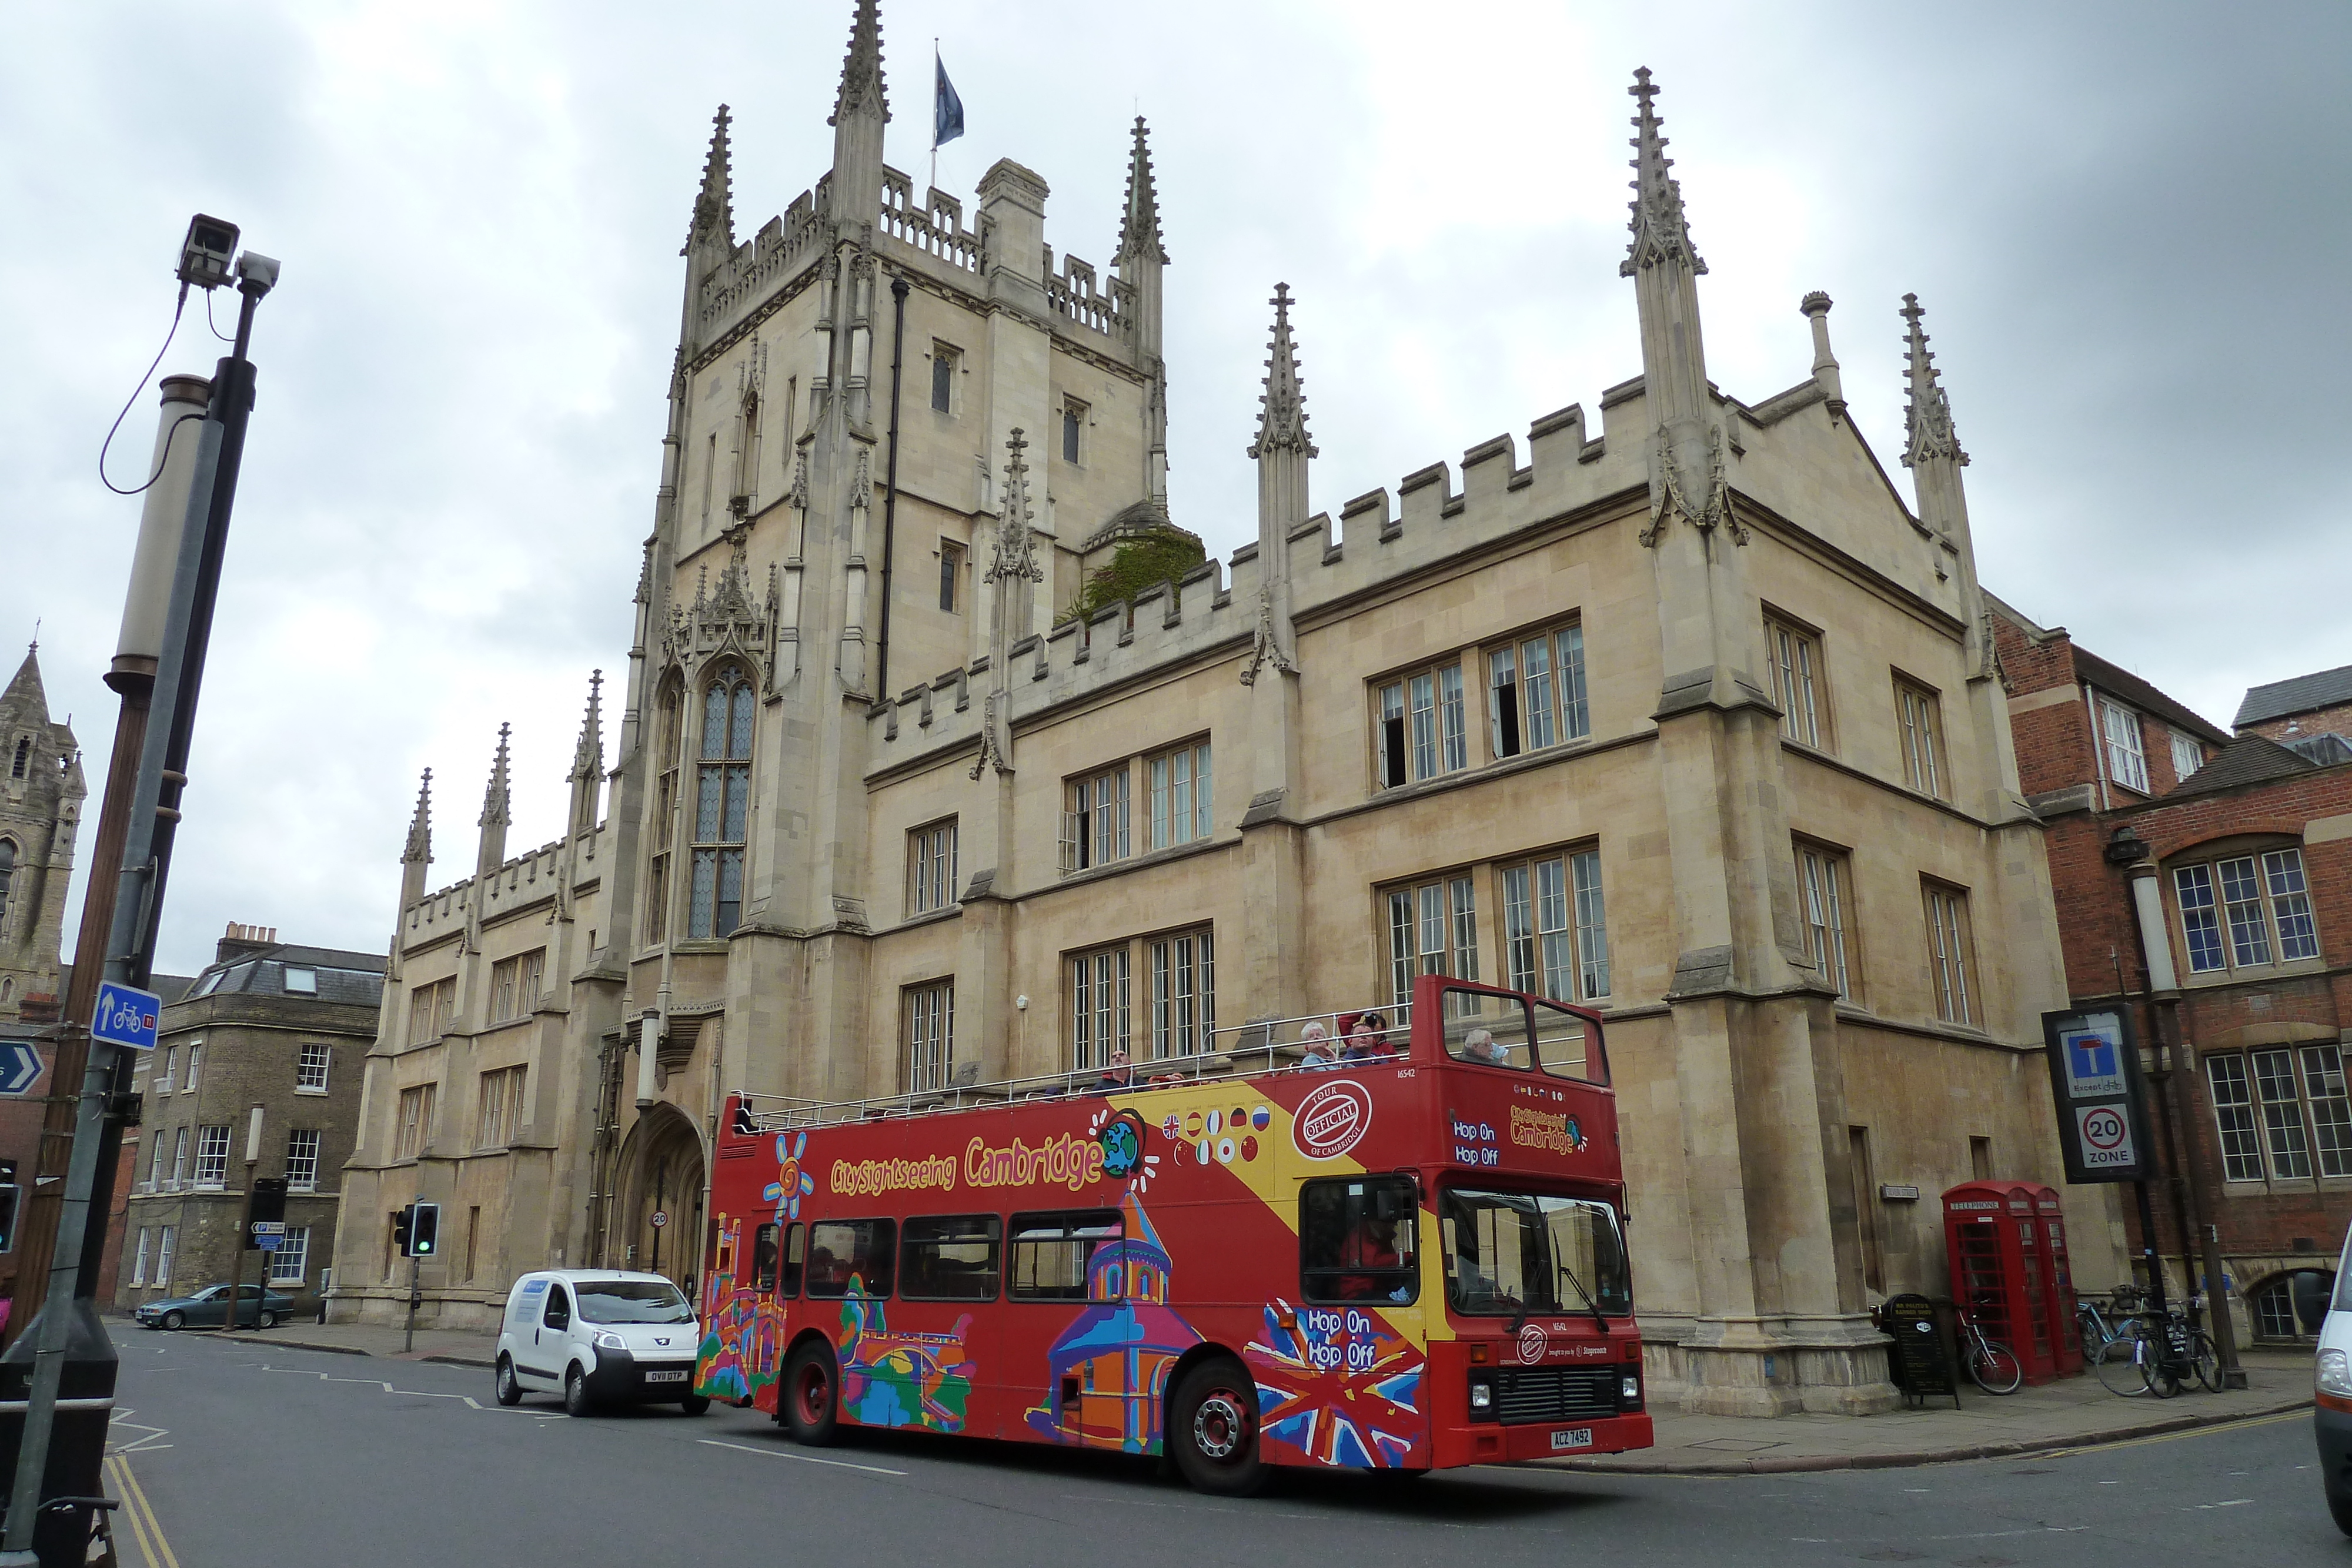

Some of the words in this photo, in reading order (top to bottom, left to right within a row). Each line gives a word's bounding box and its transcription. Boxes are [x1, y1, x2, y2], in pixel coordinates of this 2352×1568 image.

[146, 1017, 152, 1027] 11
[1397, 1068, 1416, 1078] 16542
[1311, 1086, 1337, 1105] TOUR
[2073, 1084, 2102, 1092] Except
[1305, 1105, 1356, 1138] OFFICIAL
[1510, 1105, 1566, 1130] CitySightseeing
[1454, 1121, 1477, 1141] Hop
[1479, 1123, 1495, 1141] On
[1510, 1118, 1574, 1156] Cambridge
[2089, 1119, 2118, 1137] 20
[1311, 1147, 1321, 1156] OF
[1322, 1125, 1361, 1156] CAMBRIDGE
[830, 1154, 957, 1196] CitySightseeing
[964, 1132, 1105, 1192] Cambridge
[1455, 1146, 1479, 1165] Hop
[1481, 1148, 1498, 1165] Off
[2089, 1151, 2129, 1163] ZONE
[1308, 1310, 1341, 1335] Hop
[1347, 1310, 1371, 1333] On
[1308, 1342, 1342, 1368] Hop
[1348, 1342, 1375, 1366] Off
[1583, 1346, 1607, 1357] Stagecoach
[1555, 1433, 1569, 1446] ACZ
[1570, 1430, 1589, 1444] 7492
